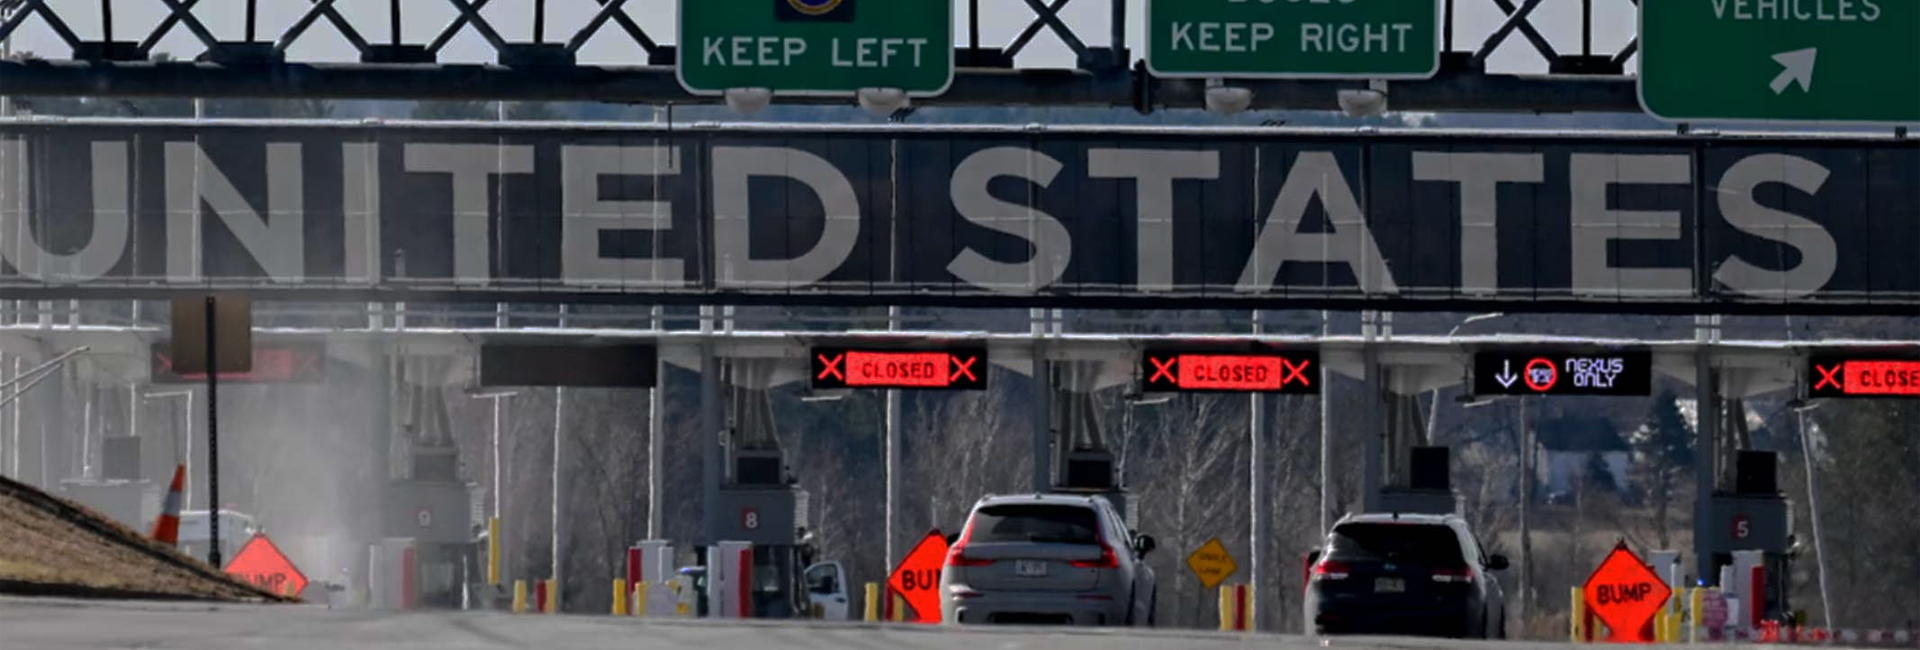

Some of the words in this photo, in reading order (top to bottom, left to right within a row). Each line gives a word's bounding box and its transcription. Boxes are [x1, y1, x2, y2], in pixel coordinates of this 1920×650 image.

[1711, 0, 1881, 21] VEHICLES
[1170, 22, 1275, 51] KEEP
[1300, 23, 1413, 52] RIGHT
[702, 36, 808, 66] KEEP
[831, 38, 928, 67] LEFT
[0, 139, 860, 289] UNITED
[946, 146, 1838, 301] STATES
[861, 361, 936, 379] CLOSED
[1193, 364, 1268, 383] CLOSED
[1573, 373, 1617, 387] ONLY
[745, 511, 758, 529] 8
[1737, 520, 1749, 538] 5
[1597, 582, 1652, 605] BUMP
